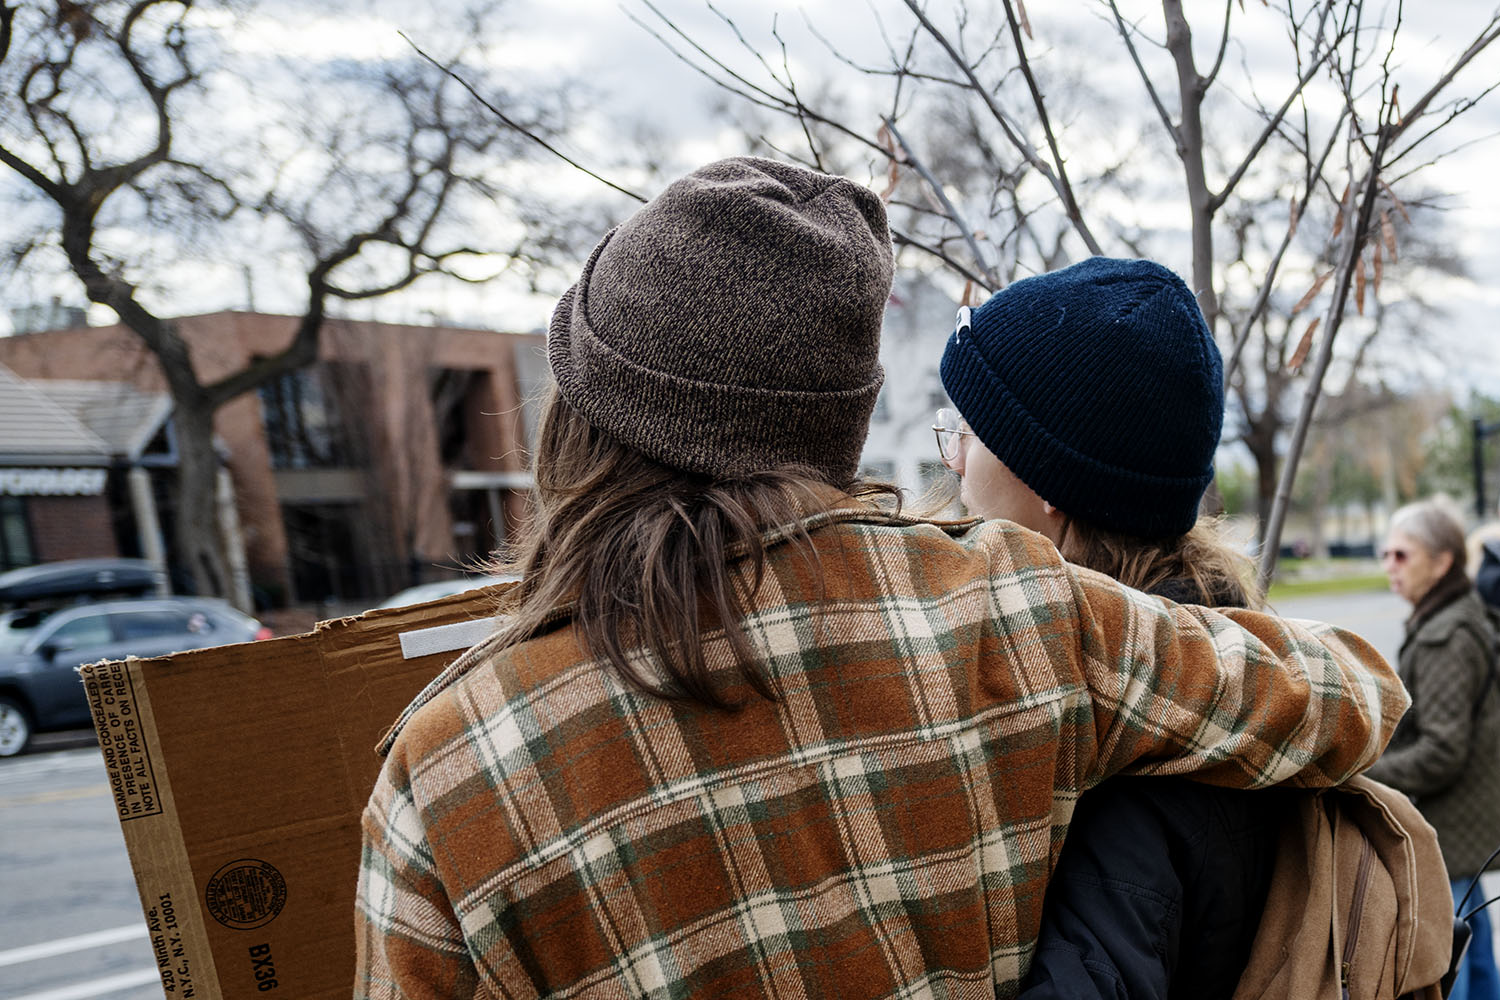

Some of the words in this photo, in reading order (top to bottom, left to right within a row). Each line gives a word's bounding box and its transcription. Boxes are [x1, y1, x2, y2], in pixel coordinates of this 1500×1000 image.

[89, 682, 112, 746] CONCEALED
[108, 712, 121, 728] OF
[119, 700, 132, 716] ON
[124, 719, 141, 754] FACTS
[105, 748, 119, 769] AND
[114, 734, 138, 796] PRESENCE
[134, 757, 147, 777] ALL
[111, 771, 130, 816] DAMAGE
[139, 782, 155, 811] NOTE
[131, 802, 142, 814] IN
[148, 906, 162, 932] Ave.
[159, 892, 178, 930] 10001
[152, 935, 171, 968] Ninth
[169, 932, 185, 958] N.Y.
[161, 969, 176, 992] 420
[248, 943, 279, 992] BX36
